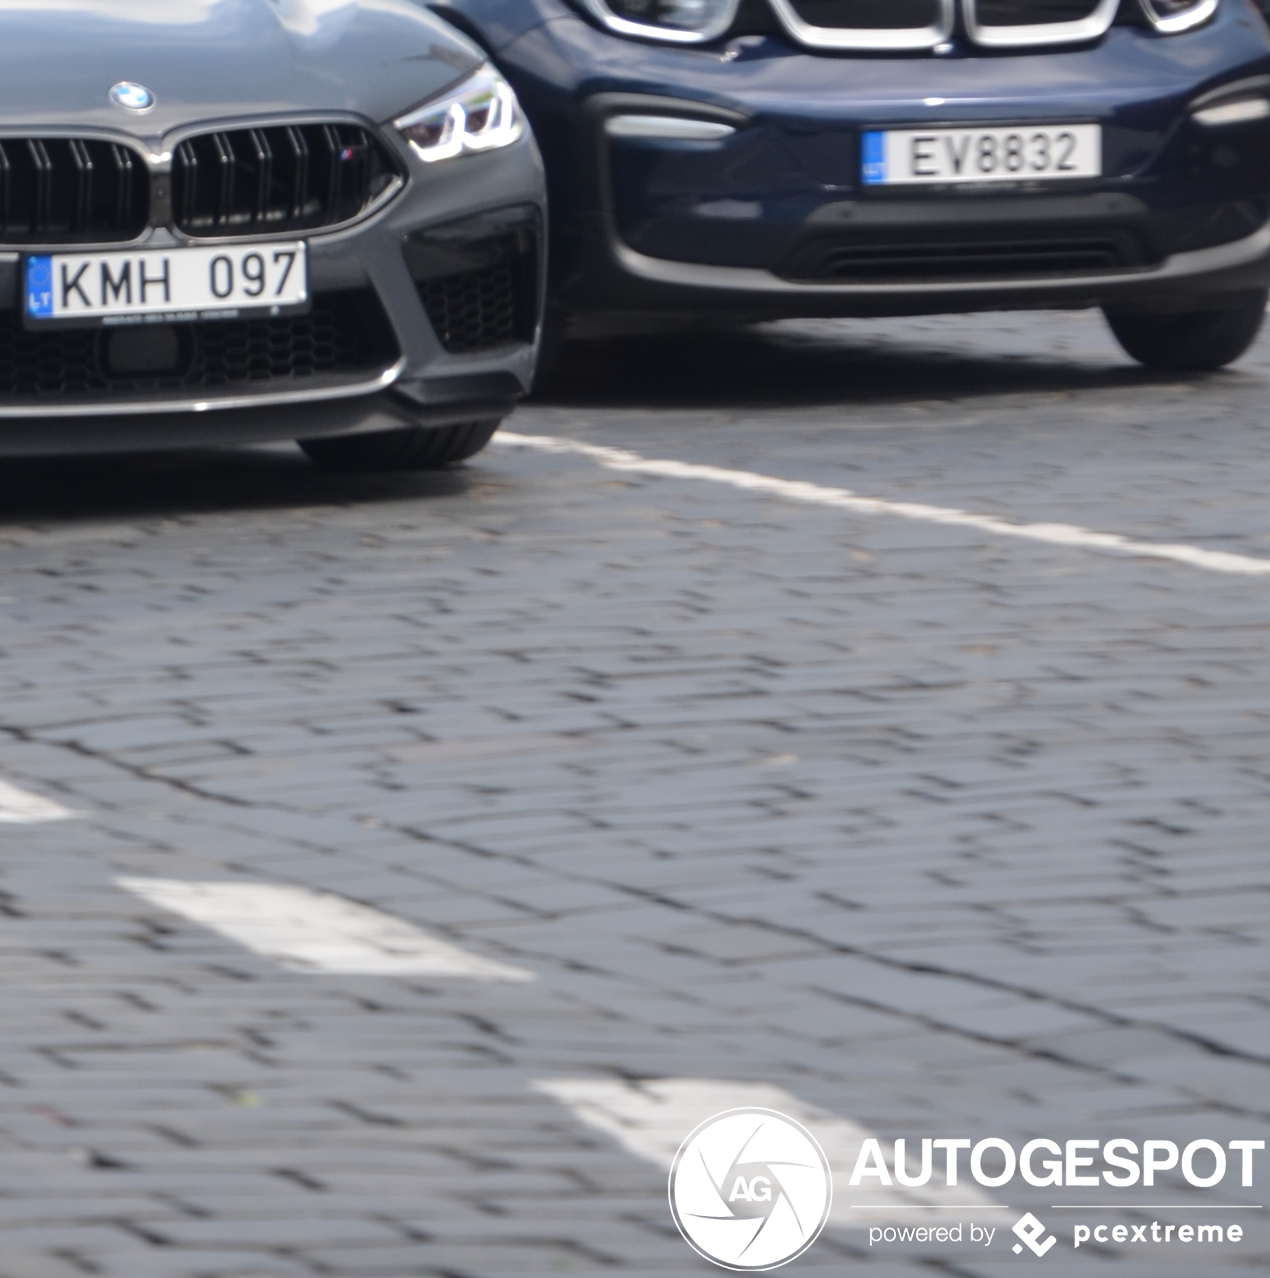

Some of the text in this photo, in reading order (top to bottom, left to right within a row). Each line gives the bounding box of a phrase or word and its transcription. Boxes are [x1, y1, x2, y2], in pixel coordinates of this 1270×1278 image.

[910, 132, 1079, 176] EV8832
[29, 292, 51, 307] LT
[60, 250, 297, 308] KMH 097
